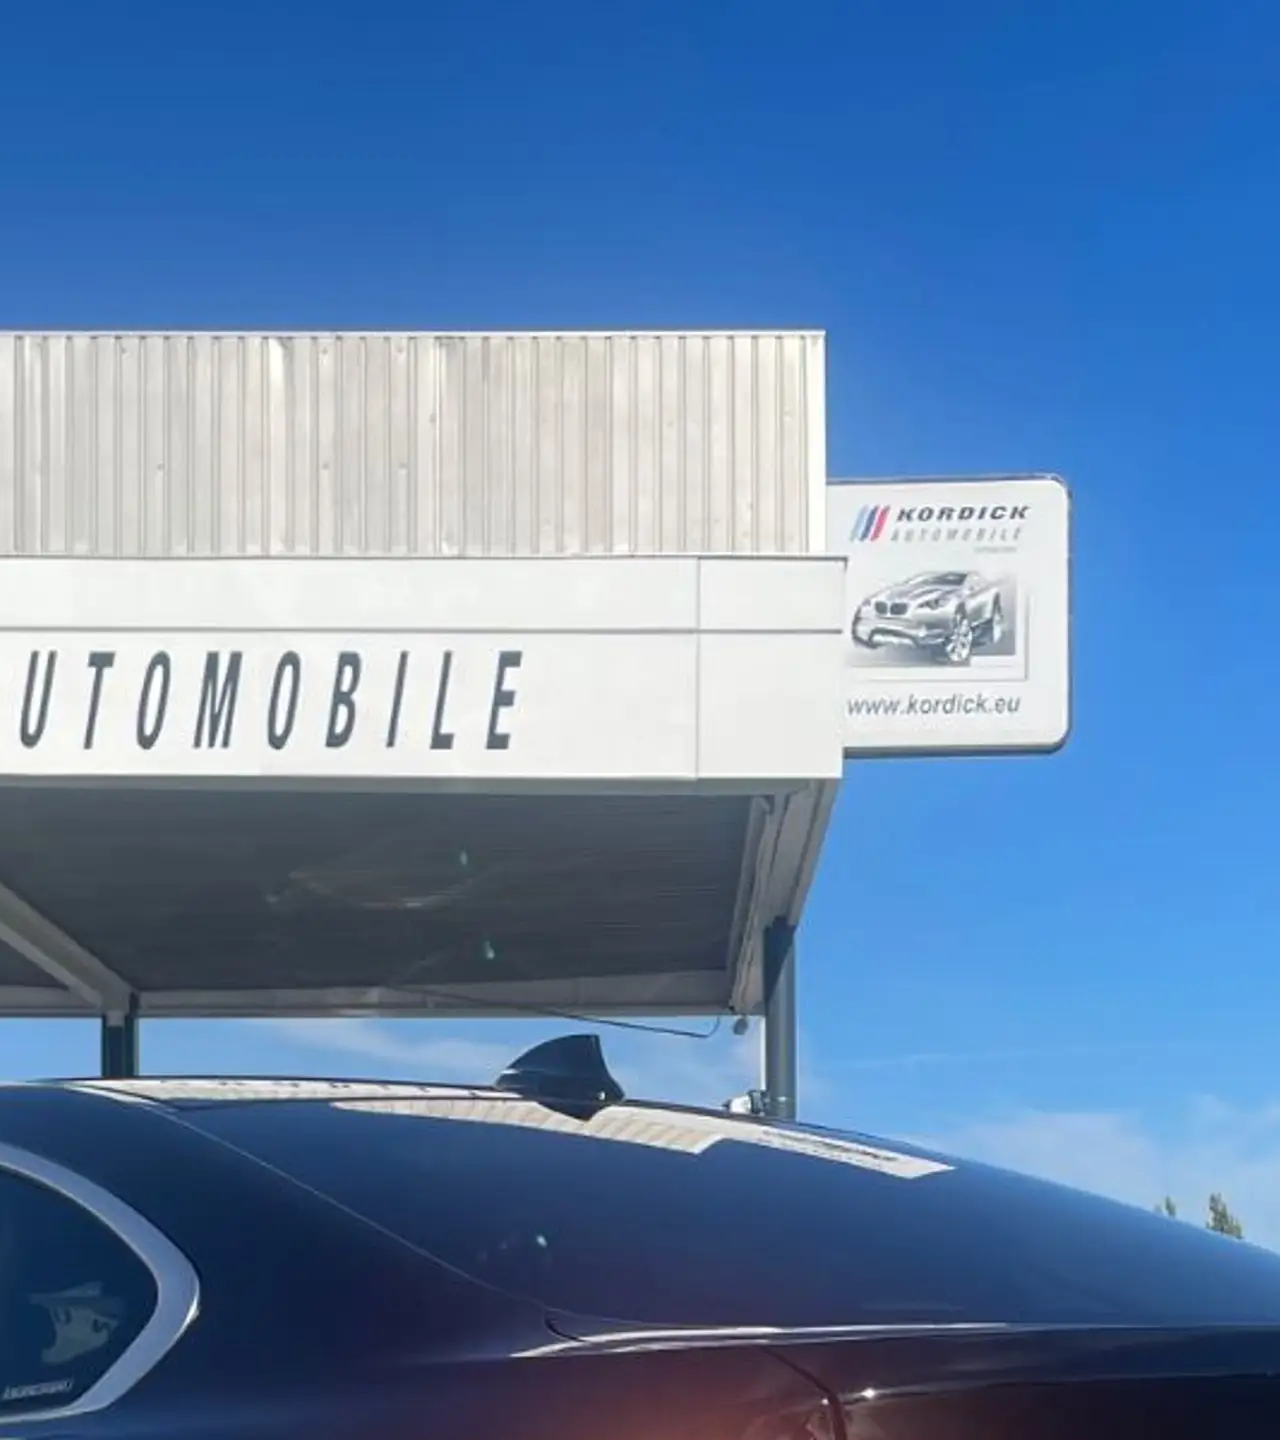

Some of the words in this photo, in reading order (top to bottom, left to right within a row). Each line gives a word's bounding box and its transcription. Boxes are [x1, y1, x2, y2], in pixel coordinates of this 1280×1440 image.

[896, 505, 1030, 522] KORDICK
[890, 527, 1023, 543] AUTOMOBILE
[846, 693, 1022, 717] www.kordick.eu
